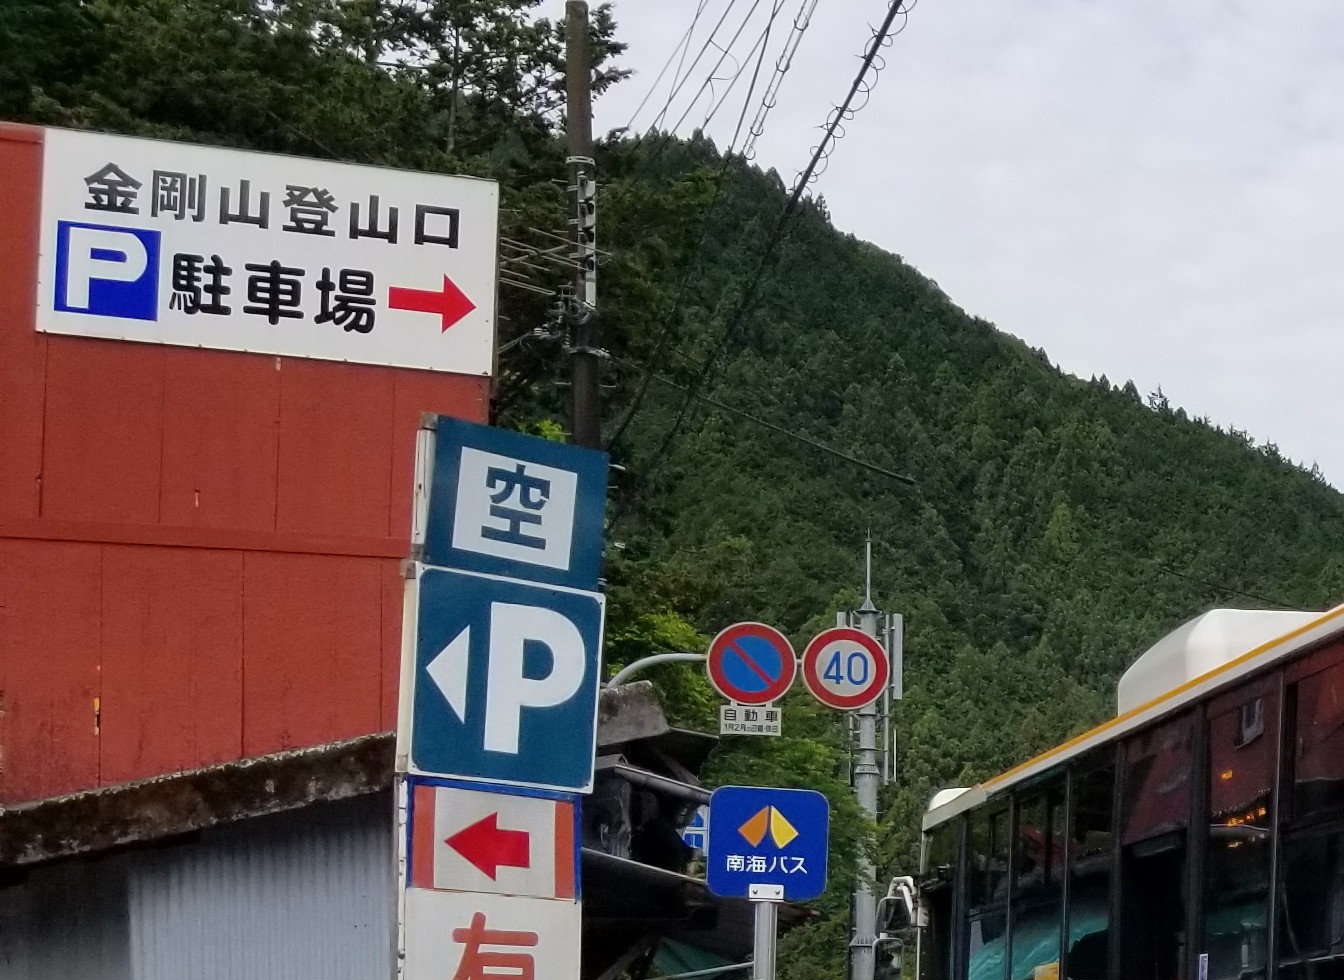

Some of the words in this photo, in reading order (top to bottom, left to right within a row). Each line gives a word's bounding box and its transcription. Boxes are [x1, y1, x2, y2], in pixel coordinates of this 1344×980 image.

[84, 161, 461, 249] 金剛山登山口
[65, 226, 148, 310] P
[168, 254, 378, 334] 駐車場
[481, 462, 551, 551] 空
[483, 601, 586, 755] P
[823, 651, 869, 686] 40
[725, 708, 778, 722] 自動車
[726, 854, 809, 875] 南海バス
